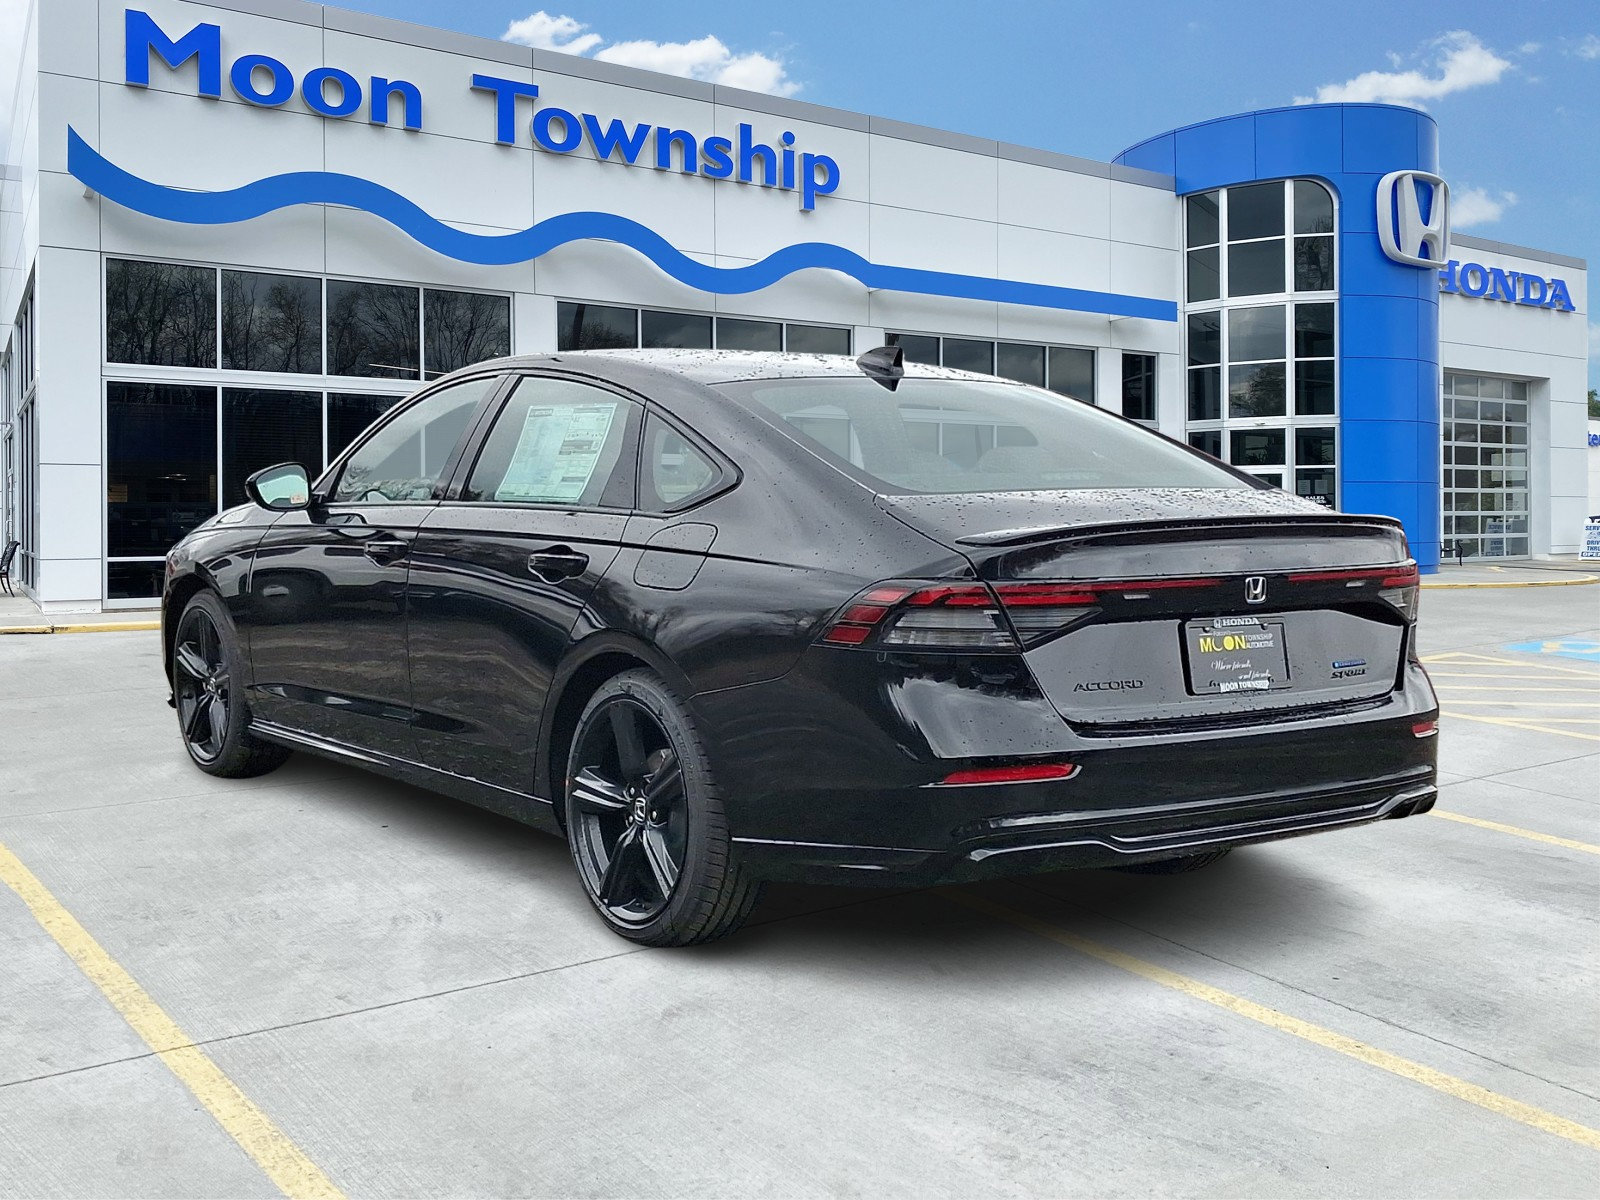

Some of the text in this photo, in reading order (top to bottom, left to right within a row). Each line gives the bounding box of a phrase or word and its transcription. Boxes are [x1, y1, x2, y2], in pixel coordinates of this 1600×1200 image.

[125, 9, 840, 211] Moon Township
[1439, 260, 1576, 311] HONDA
[1222, 617, 1260, 626] HONDA
[1199, 634, 1247, 653] MOON
[1073, 679, 1144, 692] ACCORD
[1220, 680, 1270, 693] MOON TOWNSHIP
